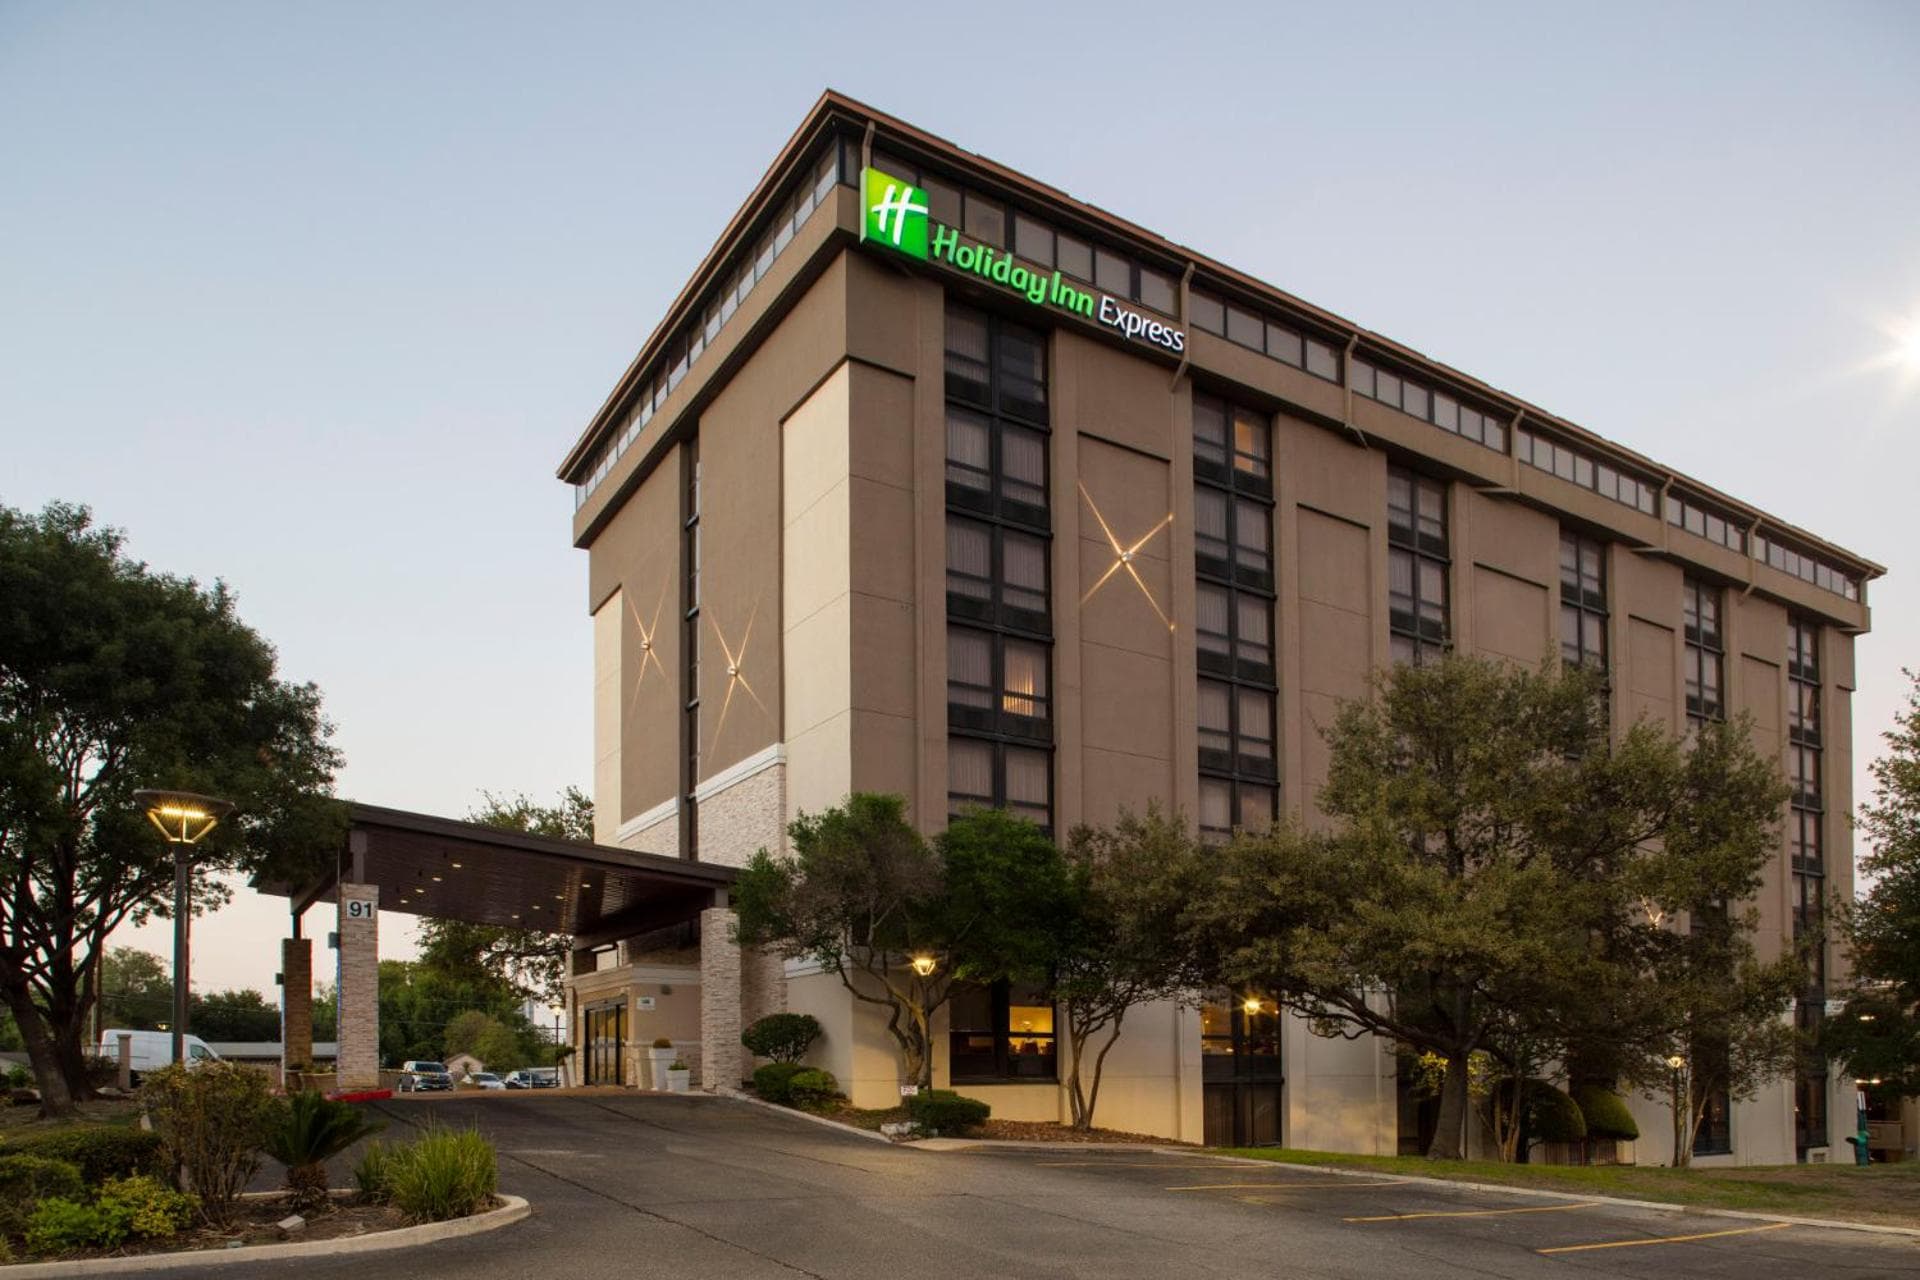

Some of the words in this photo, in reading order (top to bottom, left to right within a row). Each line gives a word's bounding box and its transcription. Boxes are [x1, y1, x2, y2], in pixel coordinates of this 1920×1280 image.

[932, 224, 1047, 304] Holiday
[1051, 271, 1094, 317] Inn
[1099, 295, 1184, 351] Express
[350, 901, 371, 917] 91
